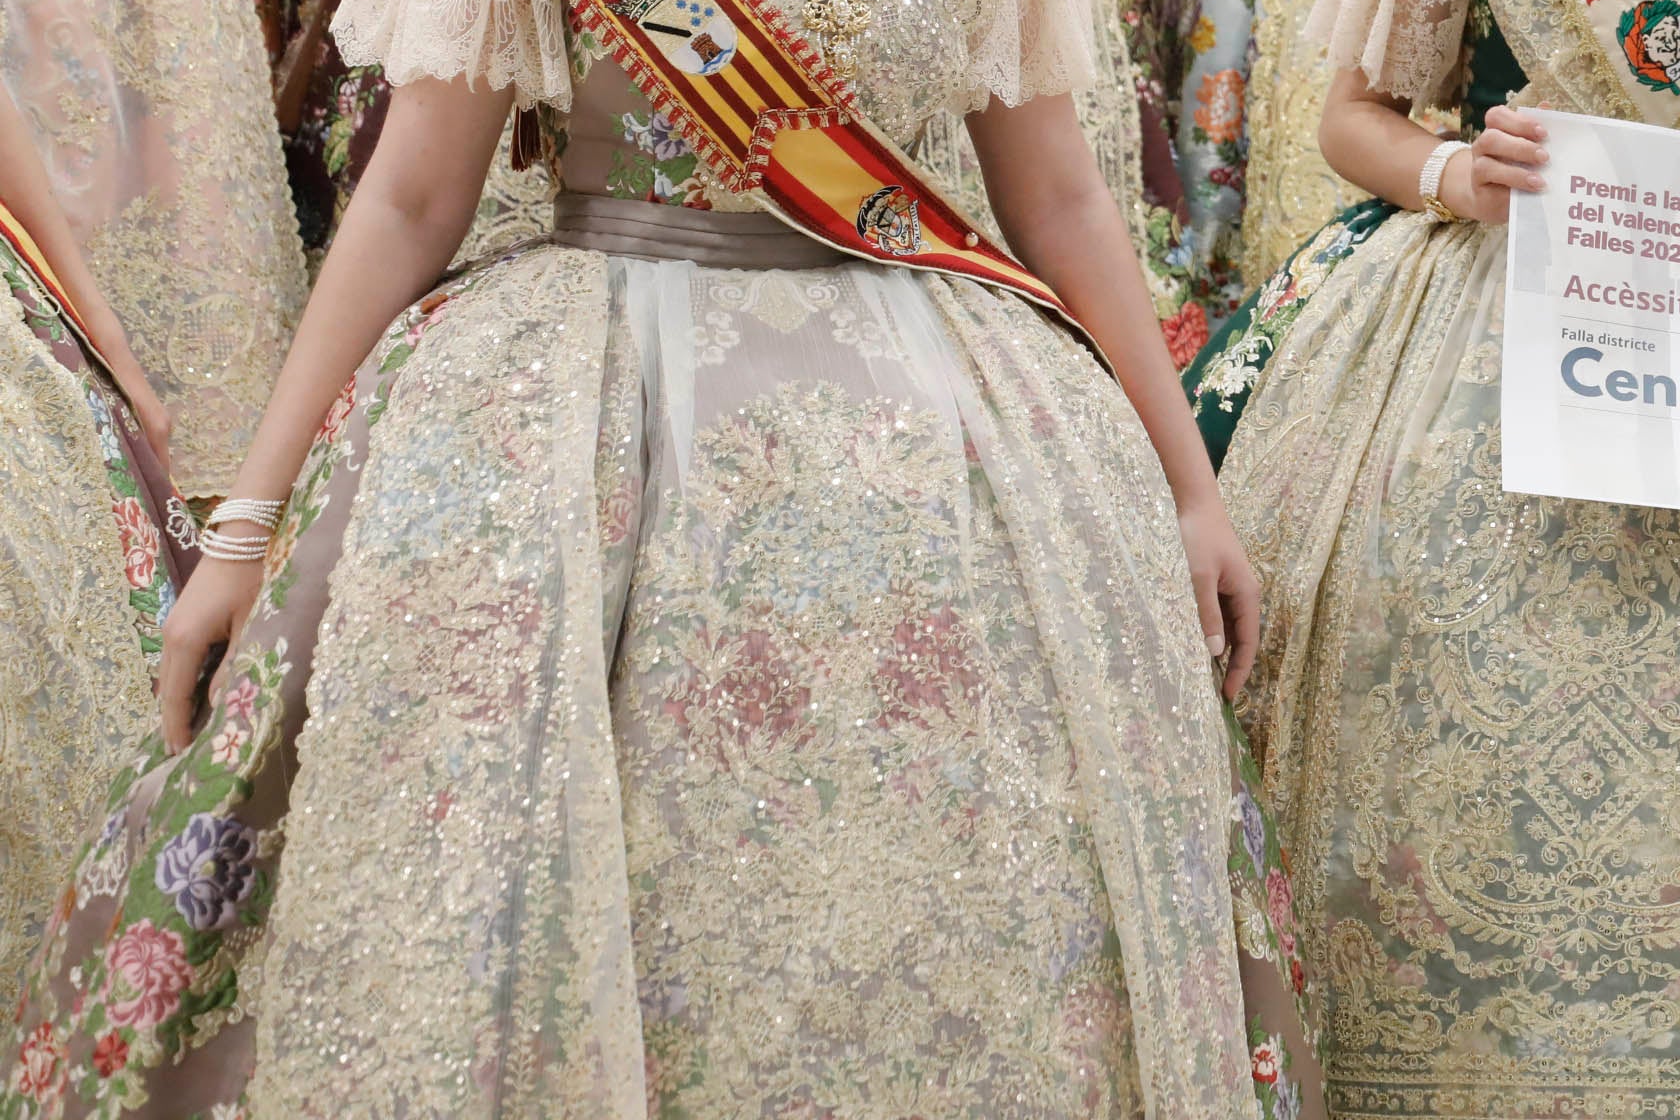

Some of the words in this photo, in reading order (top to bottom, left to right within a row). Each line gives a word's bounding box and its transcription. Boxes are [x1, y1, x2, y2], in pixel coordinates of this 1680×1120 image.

[1570, 175, 1637, 203] Premi
[1643, 191, 1657, 207] a
[1568, 202, 1604, 223] del
[1568, 226, 1635, 255] Falles
[1561, 328, 1594, 343] Falla
[1598, 333, 1656, 352] districte
